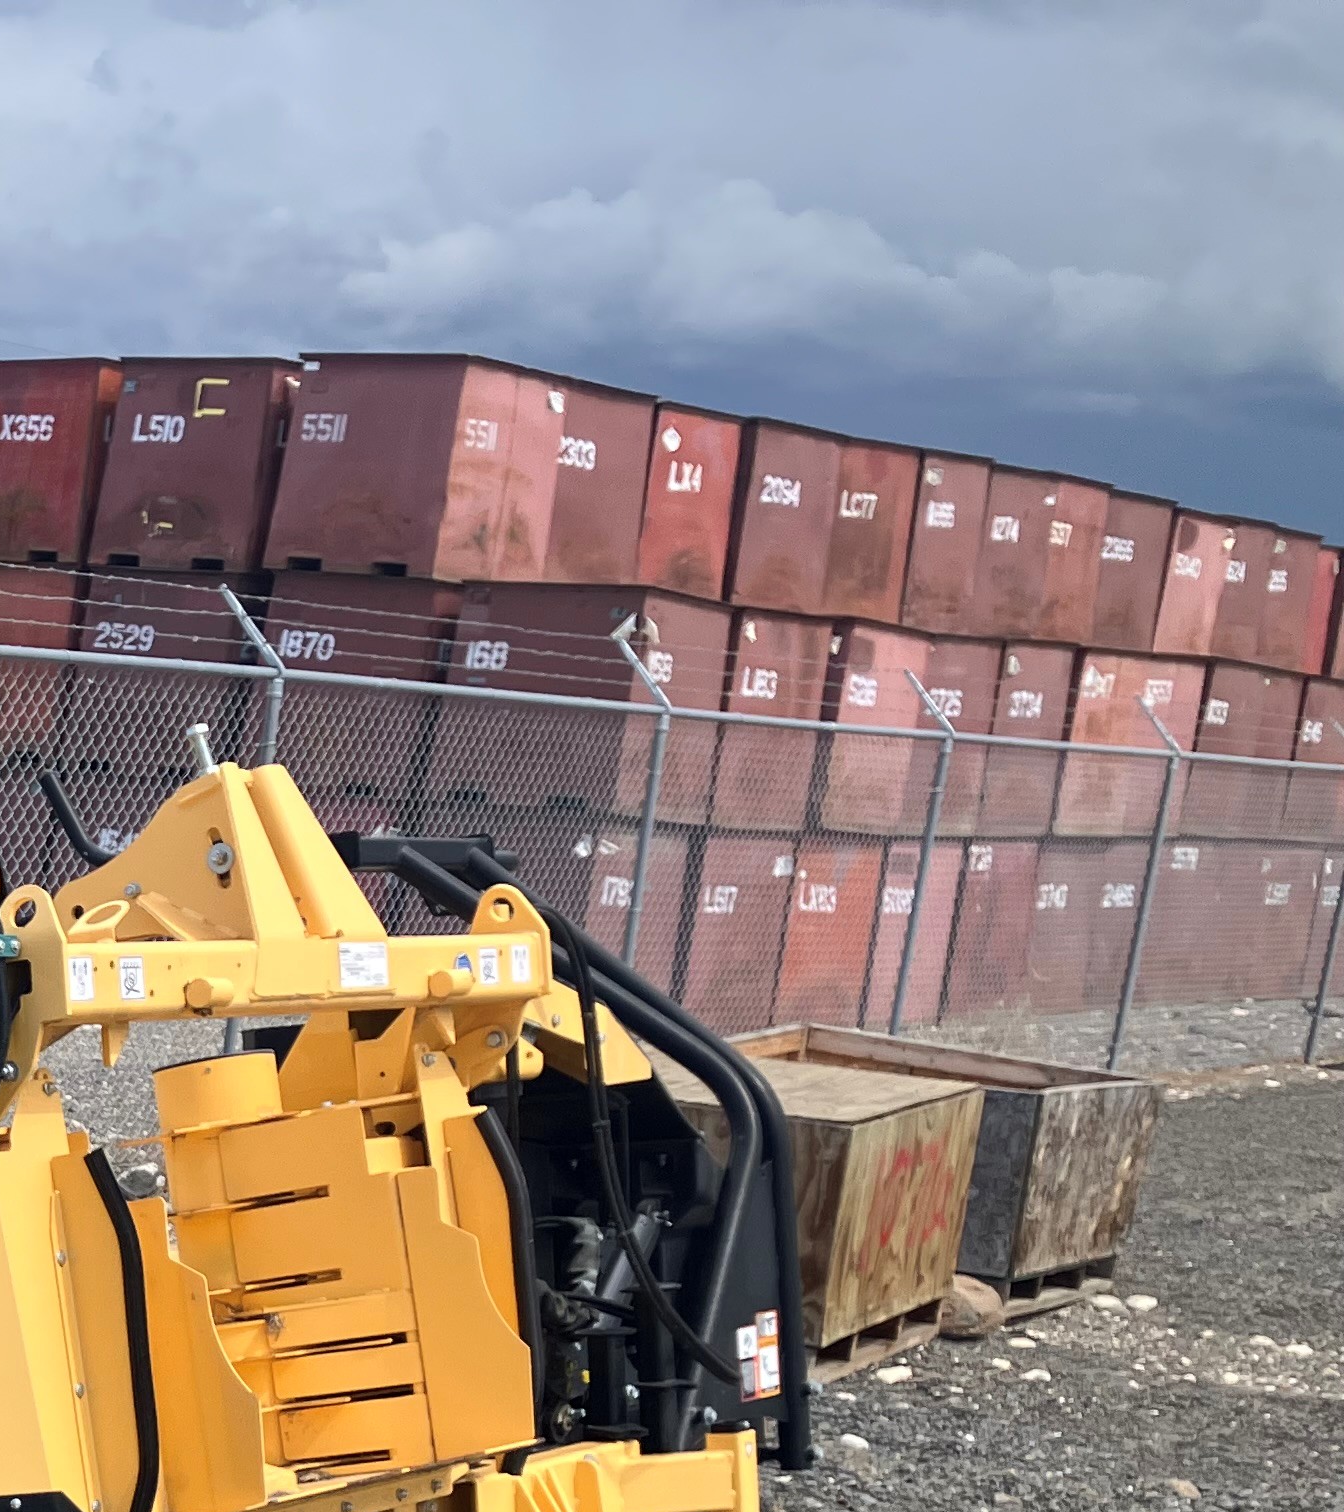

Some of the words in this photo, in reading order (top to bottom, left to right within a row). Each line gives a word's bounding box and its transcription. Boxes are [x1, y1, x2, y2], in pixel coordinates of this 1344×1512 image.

[132, 414, 185, 443] L510
[301, 414, 348, 443] 5511
[464, 419, 499, 451] 5511
[92, 621, 156, 651] 2529
[278, 628, 335, 662] 1870
[465, 640, 510, 671] 168
